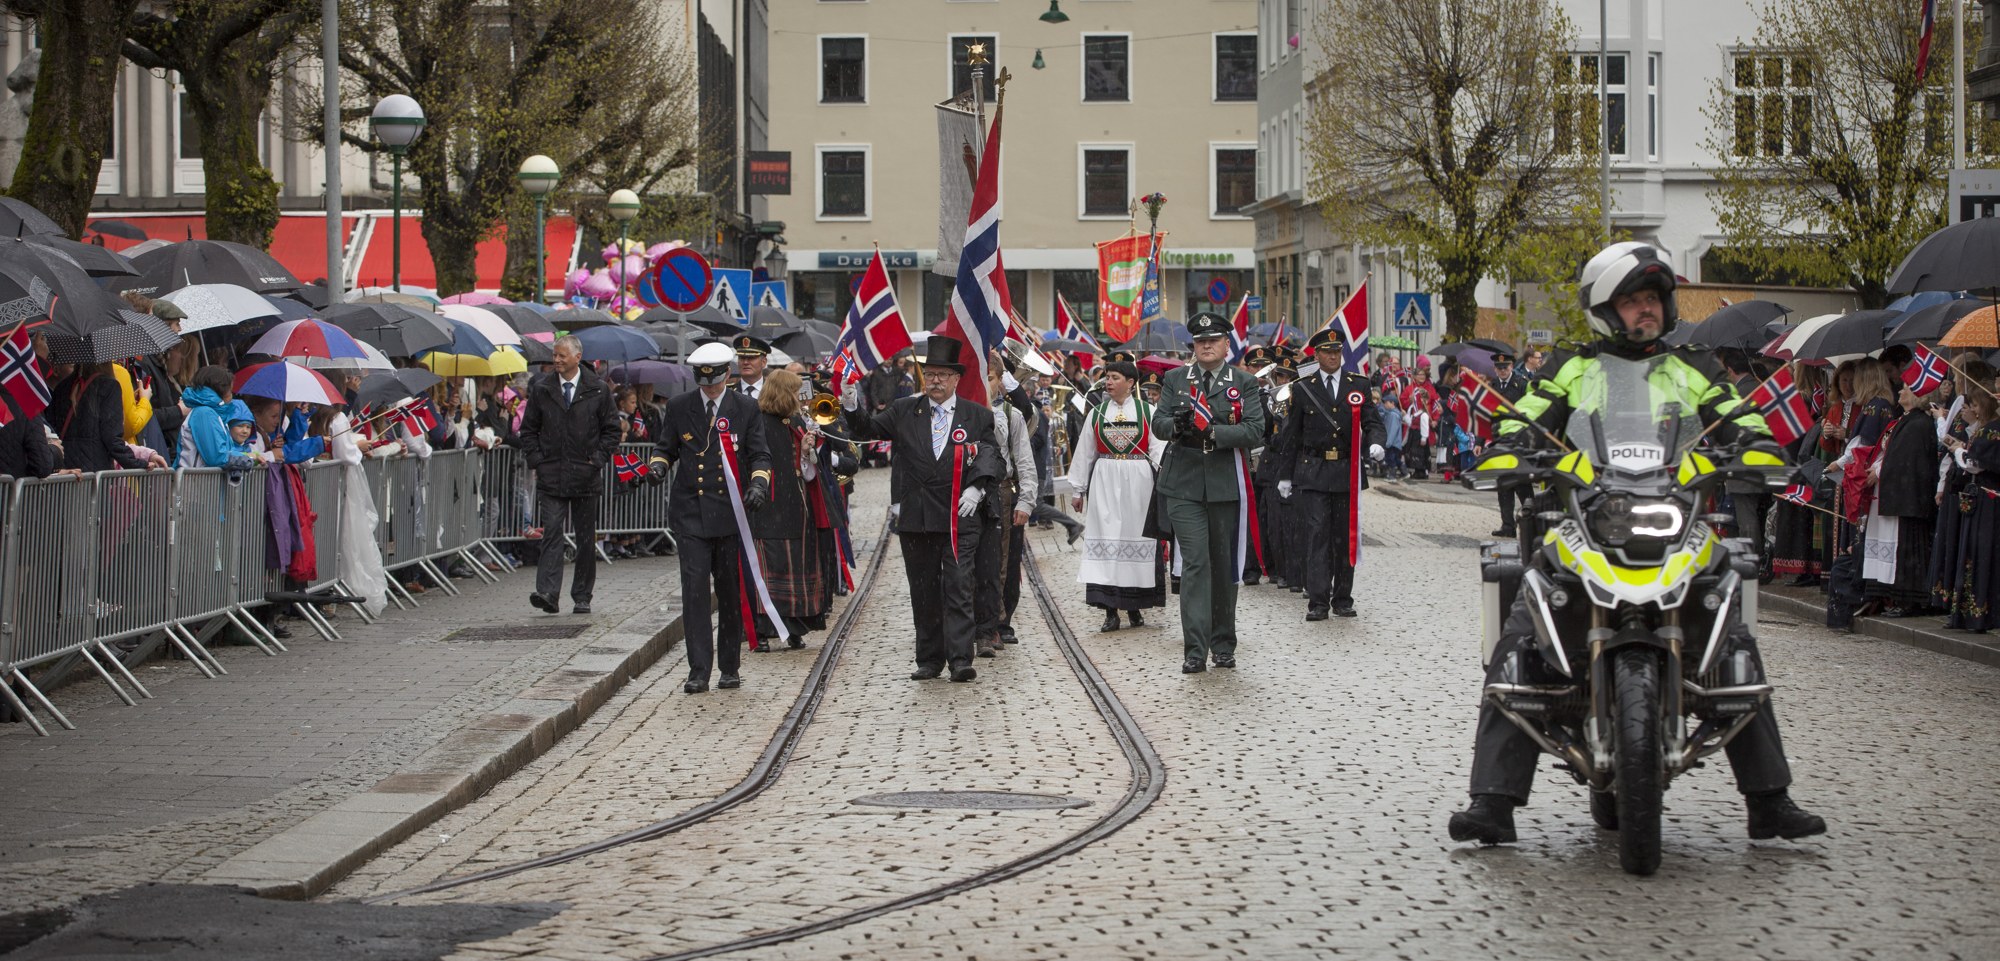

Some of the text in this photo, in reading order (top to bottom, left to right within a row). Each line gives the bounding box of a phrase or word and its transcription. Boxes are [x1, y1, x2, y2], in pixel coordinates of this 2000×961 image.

[1161, 250, 1234, 267] Krogsveen
[1611, 448, 1661, 460] POLITI
[1562, 521, 1585, 552] POLITI
[1687, 522, 1709, 553] POLITI
